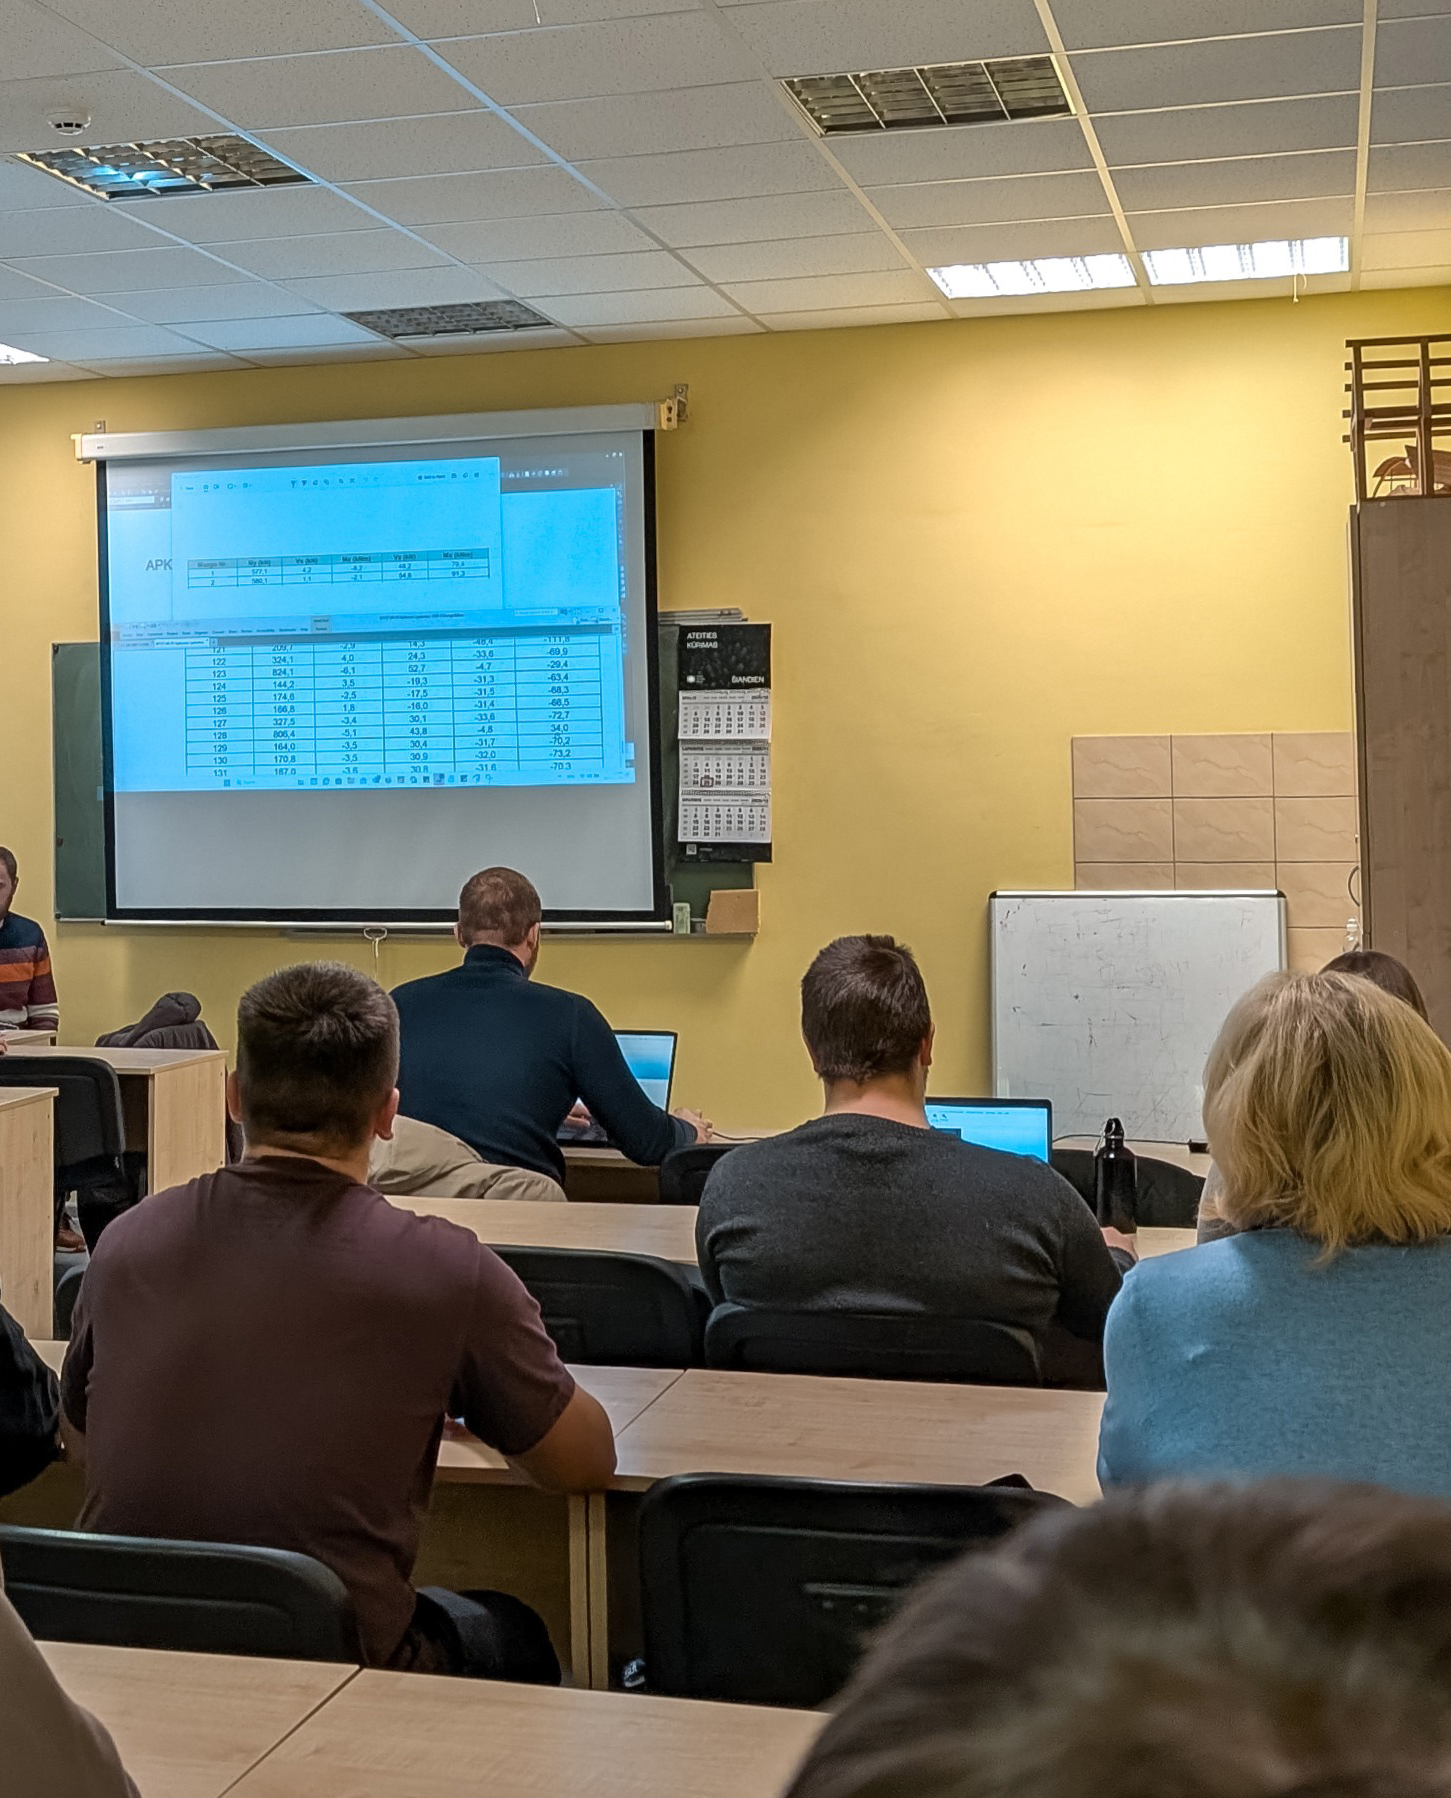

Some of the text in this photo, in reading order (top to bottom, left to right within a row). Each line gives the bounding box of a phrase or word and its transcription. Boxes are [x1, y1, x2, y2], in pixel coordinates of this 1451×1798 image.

[145, 559, 173, 571] APK
[476, 663, 492, 671] -4,7
[342, 679, 355, 688] 3,5
[474, 675, 495, 684] -31,3
[407, 689, 428, 698] -17,5
[474, 688, 495, 696] -31,5
[474, 700, 495, 709] -31,4
[341, 717, 357, 725] -3,4
[409, 715, 427, 723] 30,1
[548, 711, 570, 720] -72,7
[342, 730, 357, 738] -5,1
[410, 727, 427, 735] 43,8
[274, 743, 296, 751] 164,0
[342, 742, 358, 750] -3,5
[410, 740, 428, 748] 30,4
[475, 738, 496, 747] -31,7
